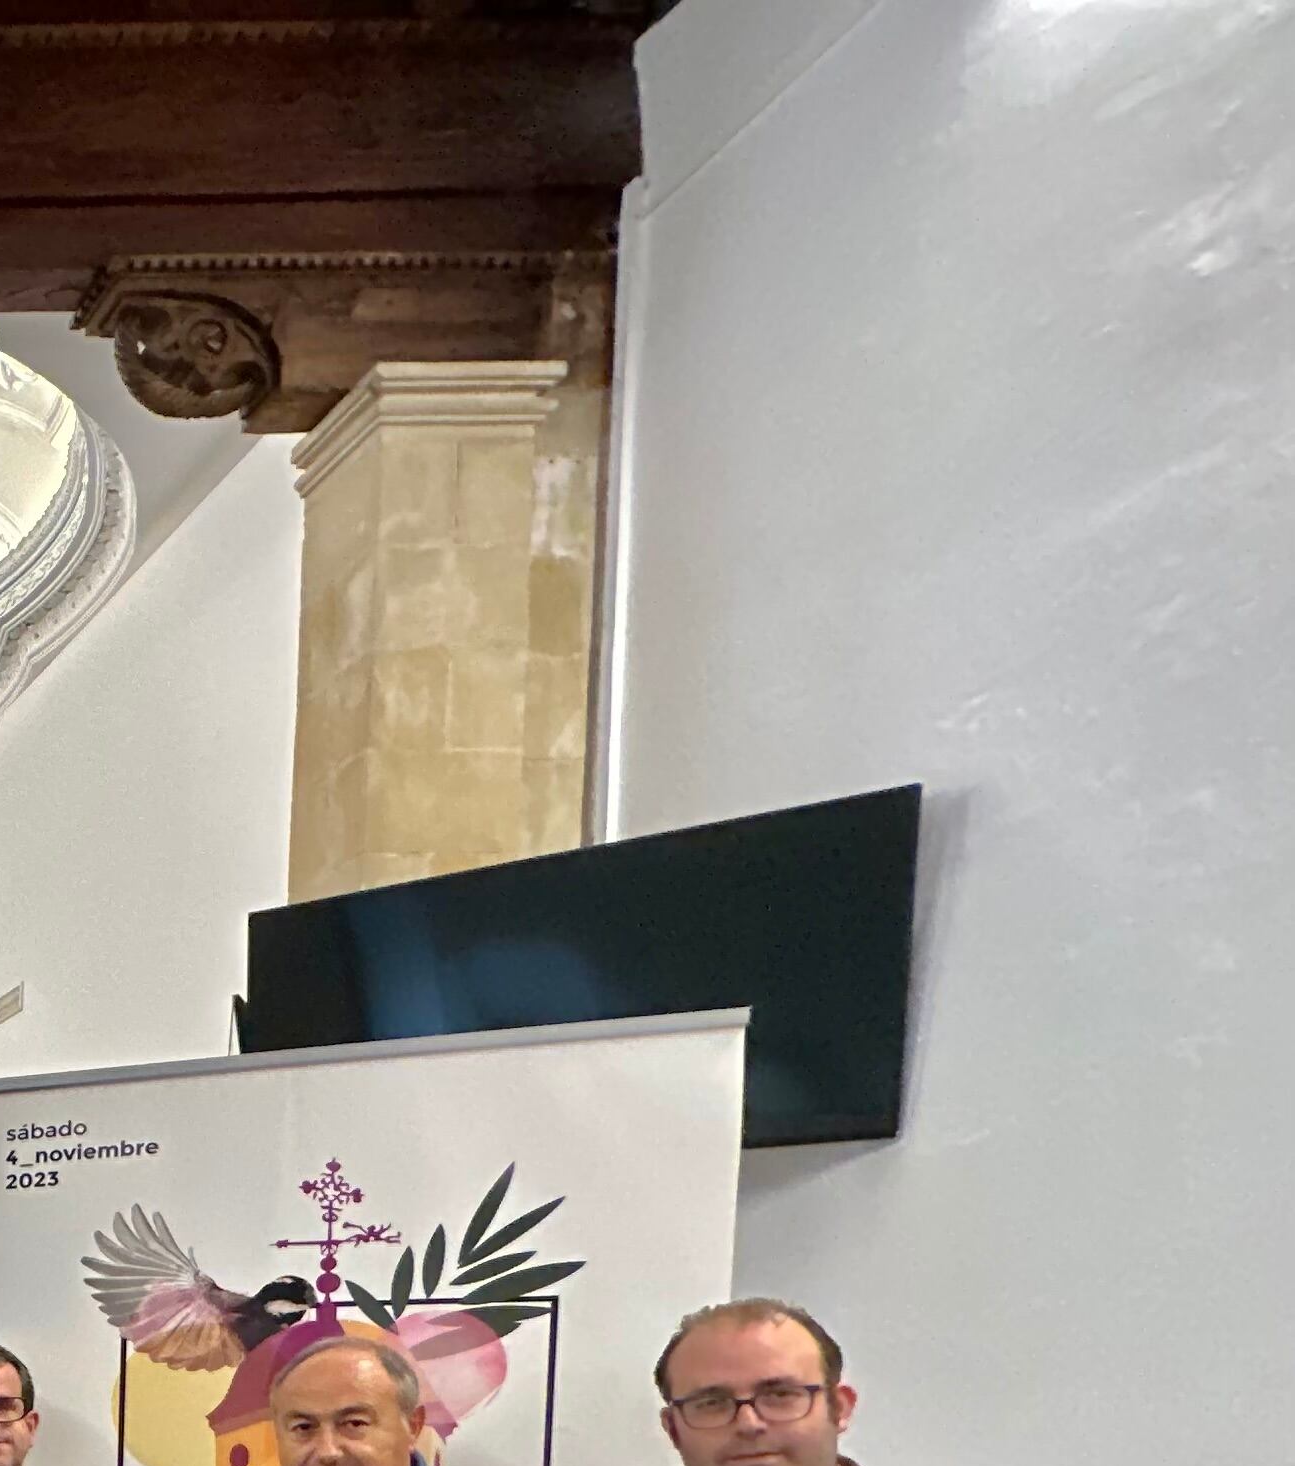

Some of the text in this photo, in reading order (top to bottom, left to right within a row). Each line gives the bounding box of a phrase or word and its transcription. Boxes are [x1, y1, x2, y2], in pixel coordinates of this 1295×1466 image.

[6, 1120, 88, 1142] sábado
[5, 1140, 159, 1168] 4_noviembre
[5, 1171, 59, 1190] 2023
